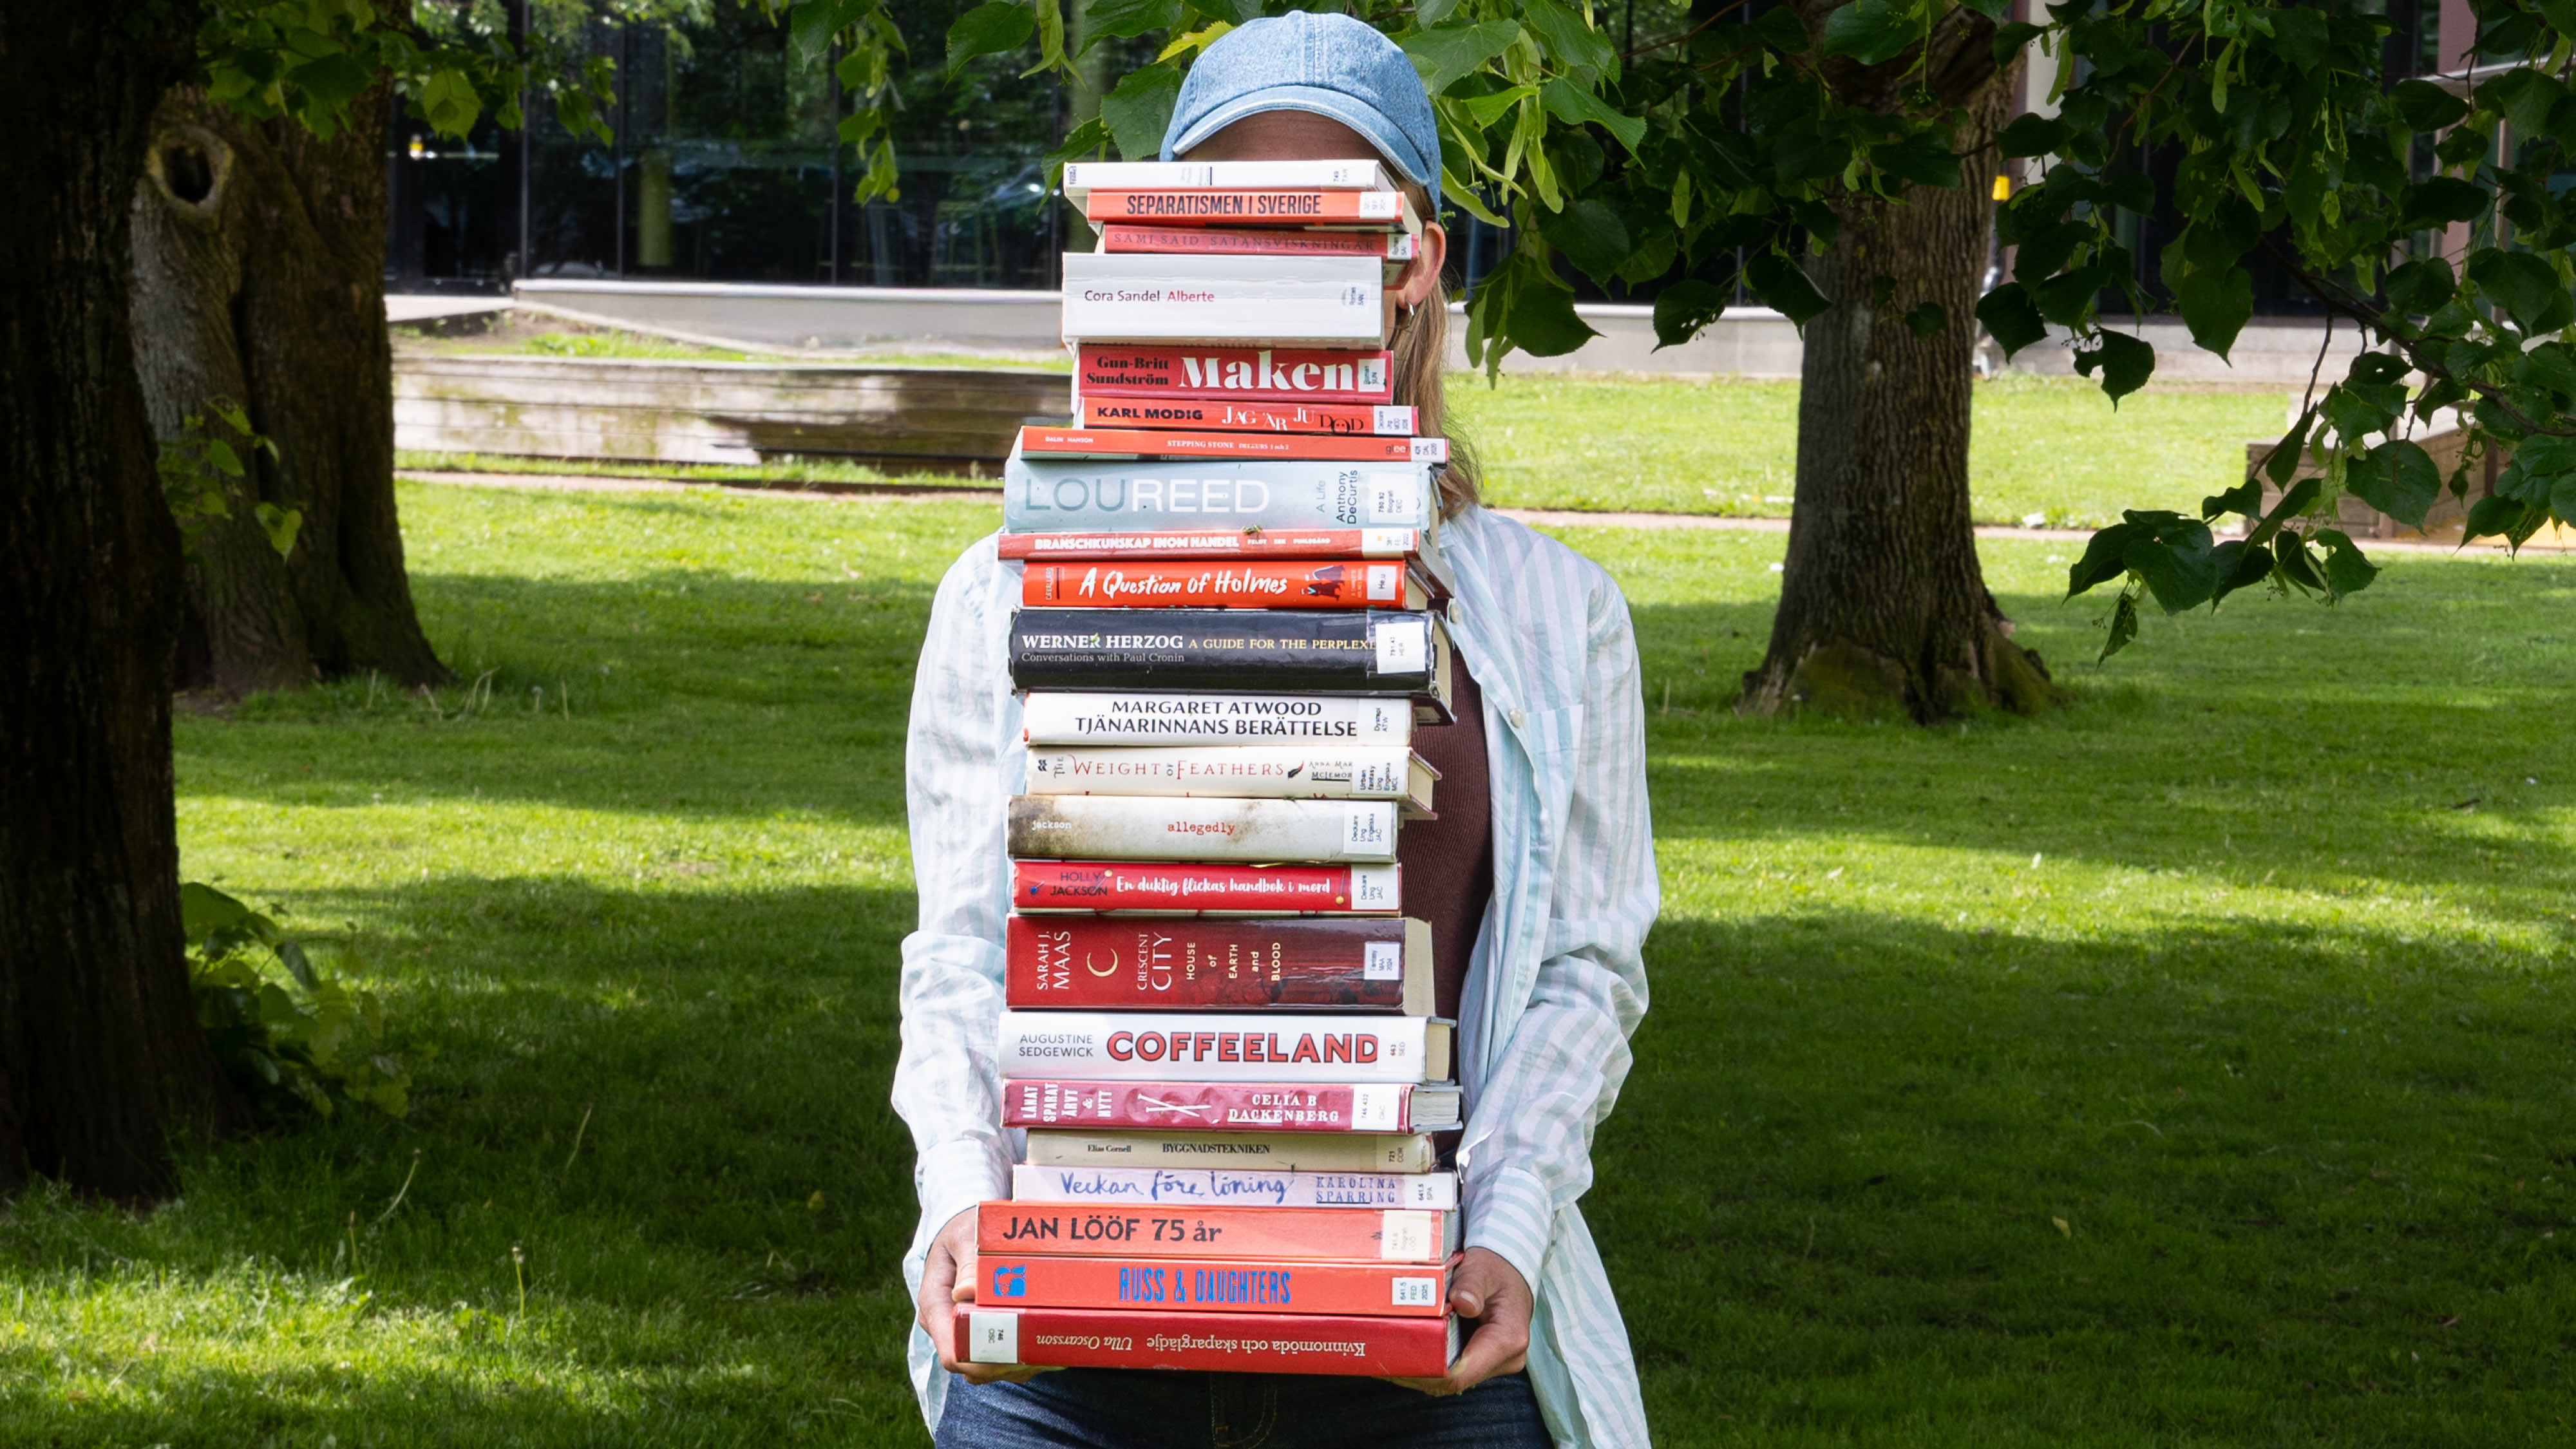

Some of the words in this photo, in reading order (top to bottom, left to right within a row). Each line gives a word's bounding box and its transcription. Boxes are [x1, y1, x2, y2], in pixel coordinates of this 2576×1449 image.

[1127, 194, 1243, 215] SEPARATISMEN
[1248, 195, 1253, 214] I
[1258, 194, 1321, 214] SVERIGE
[1114, 233, 1153, 244] SAMI
[1160, 234, 1199, 245] SAID
[1210, 236, 1374, 252] SATANSVISKNINGAR
[1084, 290, 1115, 302] Cora
[1117, 290, 1160, 303] Sandel
[1167, 290, 1215, 303] Alberte
[1097, 355, 1169, 371] Gun-Britt
[1179, 350, 1355, 391] Maken
[1086, 372, 1169, 386] Sundström
[1097, 406, 1142, 418] KARL
[1144, 407, 1203, 420] MODIG
[1222, 405, 1257, 424] JAG
[1262, 411, 1288, 431] ÄR
[1293, 406, 1315, 423] JU
[1167, 439, 1206, 449] STEPPING
[1208, 440, 1235, 450] STONE
[1316, 480, 1326, 500] Life
[1336, 471, 1348, 522] Anthony
[1347, 469, 1358, 524] DeCurtis
[1316, 504, 1325, 513] A
[1035, 537, 1151, 551] BRANSCHKUNSKAP
[1153, 537, 1188, 549] INOM
[1190, 536, 1239, 549] HANDEL
[1079, 567, 1095, 597] A
[1102, 572, 1181, 598] Question
[1188, 568, 1211, 594] of
[1213, 568, 1288, 595] Holmes
[1021, 634, 1102, 649] WERNER
[1106, 634, 1184, 649] HERZOG
[1188, 639, 1198, 649] A
[1202, 638, 1244, 649] GUIDE
[1249, 638, 1274, 649] FOR
[1280, 638, 1307, 649] THE
[1021, 652, 1095, 662] Conversations
[1097, 652, 1121, 662] with
[1123, 652, 1146, 662] Paul
[1148, 652, 1185, 662] Cronin
[1112, 701, 1224, 715] MARGARET
[1227, 701, 1322, 715] ATWOOD
[1075, 715, 1229, 736] TJÄNARINNANS
[1235, 717, 1357, 737] BERÄTTELSE
[1031, 819, 1072, 831] jackson
[1167, 820, 1235, 836] allegedly
[1061, 871, 1101, 882] HOLLY
[1116, 876, 1135, 892] En
[1137, 875, 1180, 895] duktig
[1182, 876, 1227, 894] flickas
[1229, 877, 1285, 894] handbok
[1288, 879, 1293, 893] i
[1296, 878, 1330, 895] mord
[1050, 884, 1108, 896] JACKSON
[1037, 943, 1049, 990] SARAH
[1053, 931, 1071, 990] MAAS
[1137, 932, 1148, 990] CRESCENT
[1151, 932, 1172, 991] CITY
[1186, 942, 1196, 980] HOUSE
[1208, 954, 1217, 967] of
[1228, 943, 1238, 979] EARTH
[1250, 951, 1259, 972] and
[1271, 942, 1281, 981] BLOOD
[1019, 1033, 1094, 1045] AUGUSTINE
[1106, 1030, 1378, 1064] COFFEELAND
[1019, 1045, 1094, 1057] SEDGEWICK
[1021, 1086, 1038, 1118] LÅNAT
[1043, 1083, 1059, 1122] SPARAT
[1061, 1088, 1079, 1117] ÄRVT
[1081, 1097, 1094, 1109] &
[1097, 1090, 1112, 1117] NYTT
[1251, 1094, 1302, 1107] CELIA
[1307, 1095, 1317, 1107] B
[1228, 1108, 1340, 1123] DACKENBERG
[1088, 1144, 1105, 1153] Elias
[1106, 1144, 1132, 1153] Cornell
[1162, 1142, 1271, 1154] BYGGNADSTEKNIKEN
[1060, 1171, 1144, 1197] Veckan
[1151, 1170, 1205, 1202] före
[1209, 1170, 1295, 1204] löning
[1316, 1176, 1396, 1189] KAROLINA
[1316, 1190, 1396, 1204] SPARRING
[1003, 1217, 1057, 1240] JAN
[1070, 1215, 1142, 1241] LÖÖF
[1151, 1219, 1185, 1242] 75
[1193, 1217, 1222, 1242] år
[1119, 1267, 1165, 1302] RUSS
[1174, 1269, 1188, 1303] &
[1195, 1269, 1291, 1305] DAUGHTERS
[1036, 1334, 1100, 1351] Oscarsson
[1103, 1336, 1133, 1351] Ulla
[1146, 1333, 1236, 1354] skaparglädje
[1240, 1340, 1269, 1355] och
[1272, 1341, 1365, 1356] Kvinnomöda
